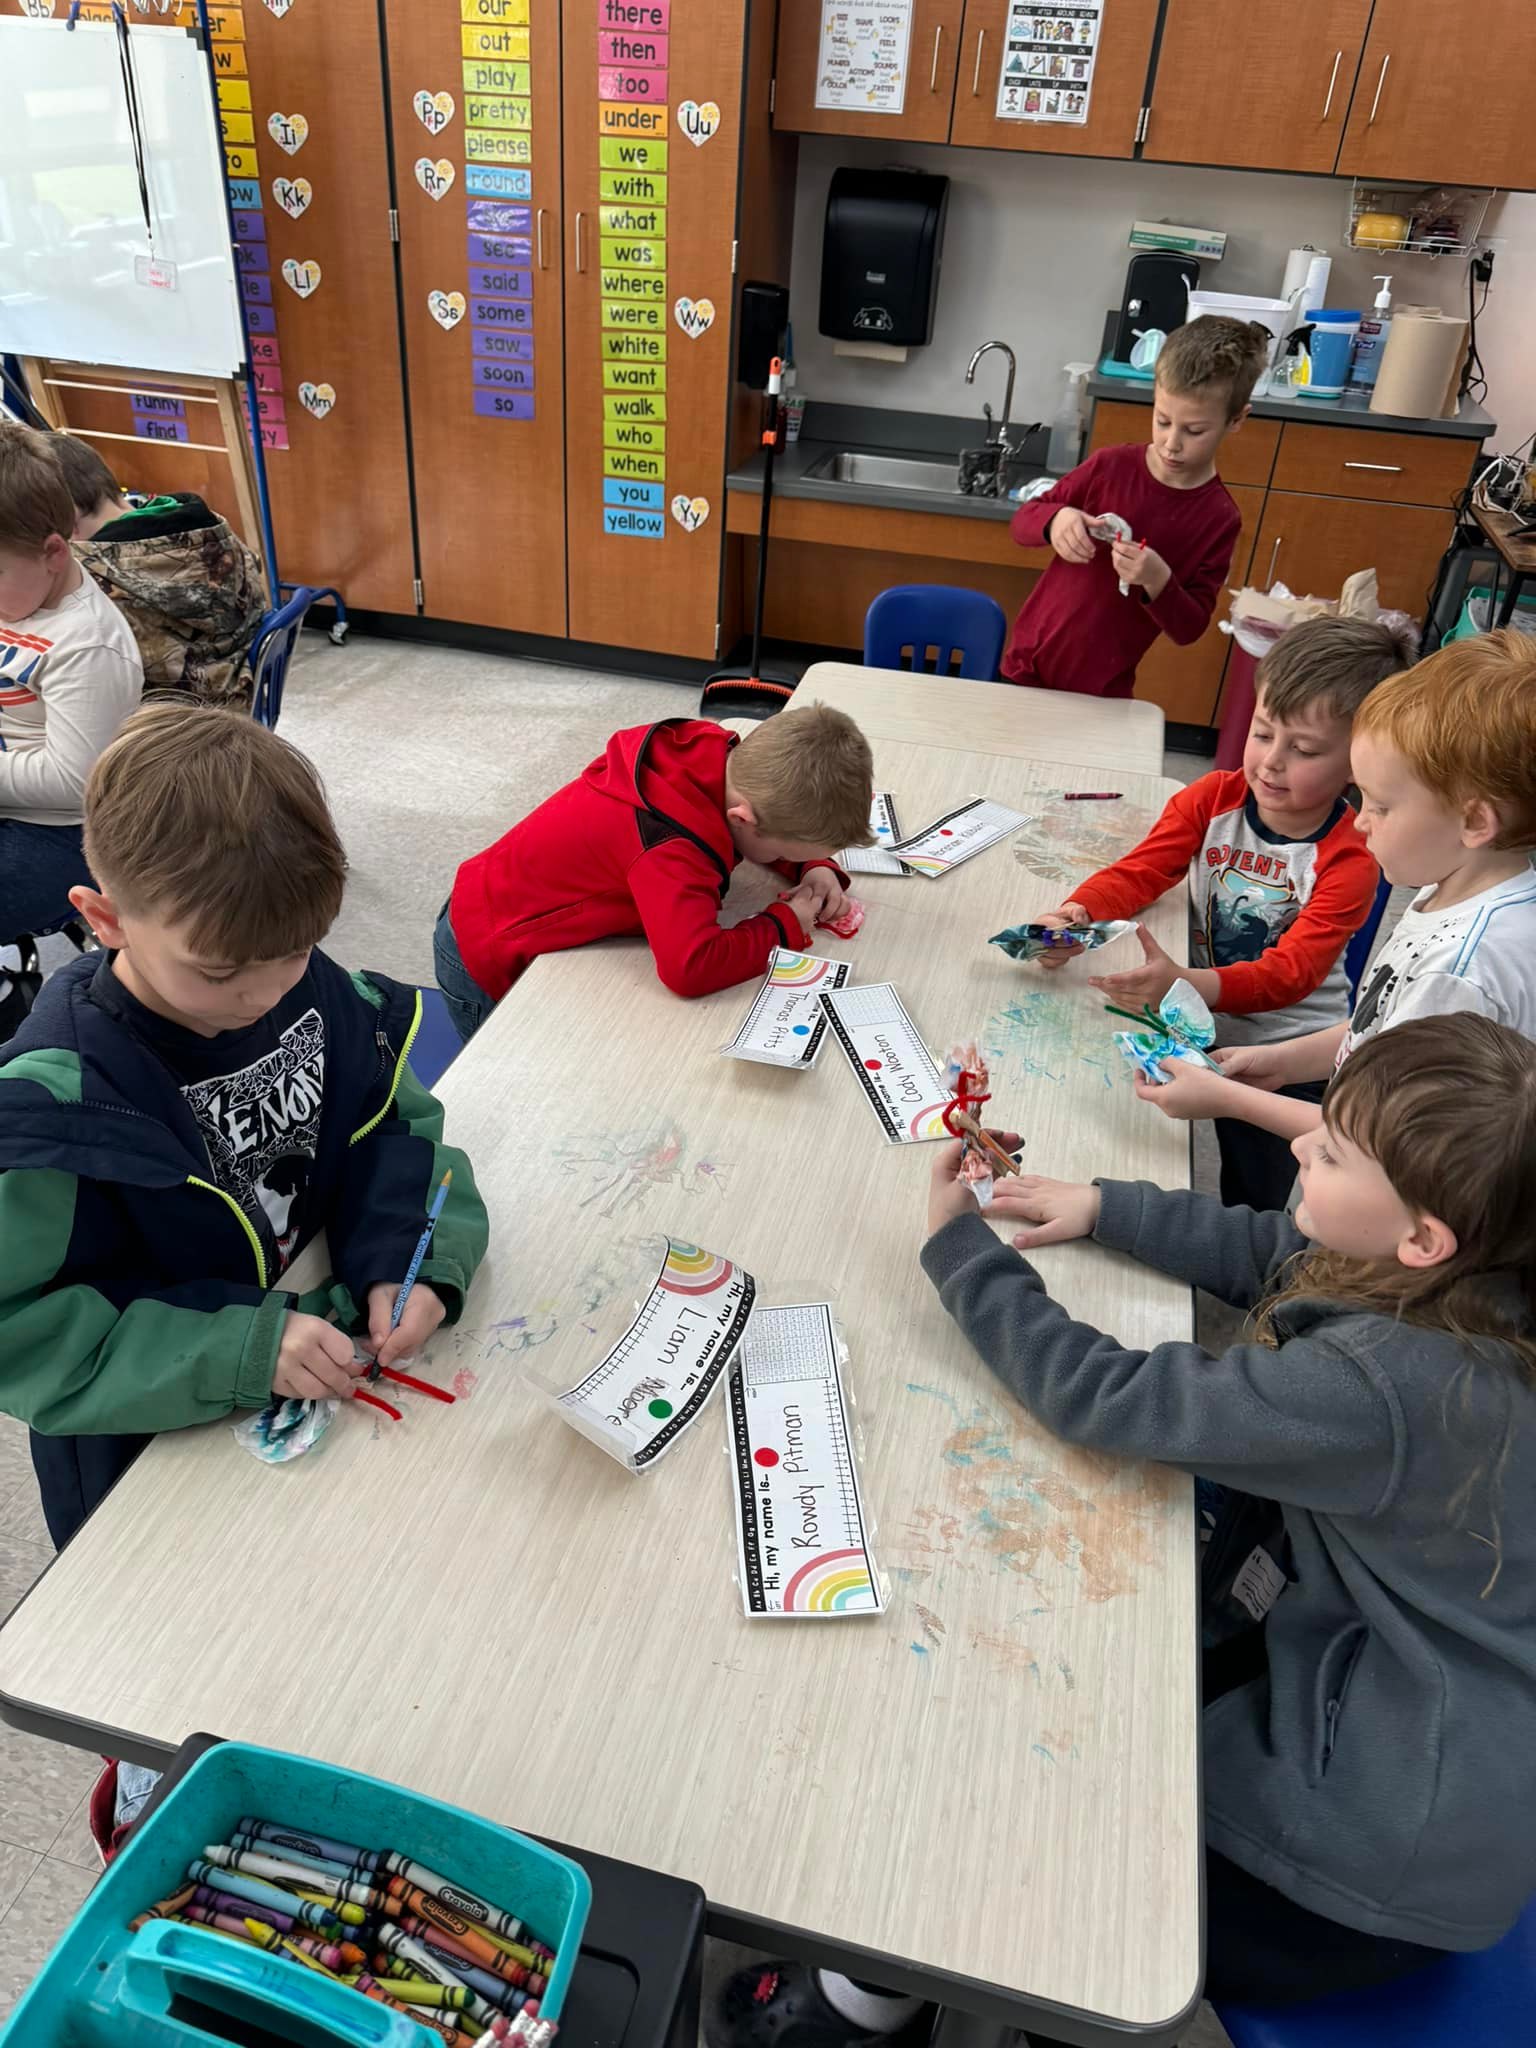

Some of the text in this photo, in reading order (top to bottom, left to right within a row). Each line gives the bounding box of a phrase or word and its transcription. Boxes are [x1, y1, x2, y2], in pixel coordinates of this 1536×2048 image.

[479, 0, 511, 16] our
[606, 0, 662, 24] there
[480, 31, 511, 52] out
[611, 37, 655, 60] then
[476, 67, 516, 88] play
[617, 73, 649, 95] too
[423, 101, 445, 126] Pp
[469, 100, 527, 121] pretty
[605, 109, 662, 130] under
[686, 110, 711, 135] Uu
[468, 133, 528, 157] please
[619, 146, 647, 163] we
[425, 167, 445, 190] Rr
[471, 170, 526, 192] round
[613, 177, 654, 198] with
[282, 186, 306, 207] Kk
[609, 210, 657, 231] what
[615, 245, 652, 263] was
[293, 269, 311, 289] Ll
[482, 272, 519, 292] said
[604, 273, 664, 295] where
[438, 299, 459, 320] Ss
[477, 304, 525, 322] some
[610, 306, 658, 324] were
[680, 309, 710, 330] Ww
[485, 335, 520, 353] saw
[609, 336, 659, 355] white
[483, 364, 524, 384] soon
[612, 368, 656, 386] want
[304, 392, 331, 408] Mm
[494, 396, 514, 412] so
[614, 398, 655, 416] walk
[147, 421, 178, 439] find
[616, 426, 652, 445] who
[611, 455, 658, 475] when
[618, 486, 649, 502] you
[608, 513, 661, 533] yellow
[680, 504, 700, 528] Yy
[764, 992, 810, 1048] Thomas Pitts
[874, 1034, 904, 1073] Wooton
[879, 1085, 892, 1103] name
[896, 1074, 923, 1102] Cody
[889, 1105, 900, 1117] my
[727, 1281, 744, 1299] Hi,
[717, 1304, 733, 1327] my
[696, 1330, 721, 1368] name
[605, 1307, 708, 1426] Liam Moore
[782, 1405, 825, 1548] Rowdy Pitman
[762, 1497, 775, 1539] name
[765, 1545, 779, 1566] my
[764, 1572, 780, 1590] Hi,
[440, 1888, 482, 1918] Crayola
[427, 1900, 466, 1933] Crayola
